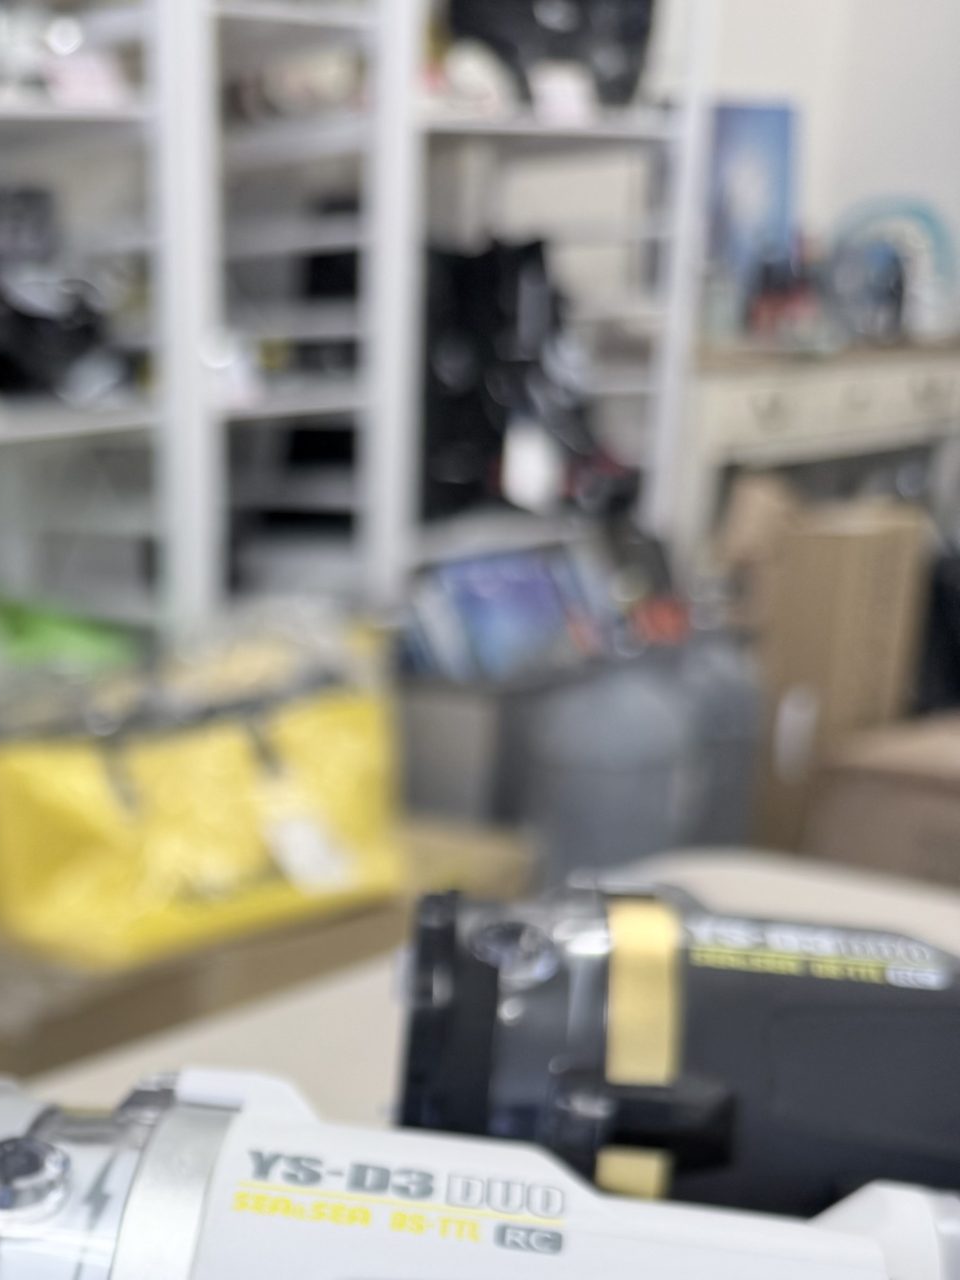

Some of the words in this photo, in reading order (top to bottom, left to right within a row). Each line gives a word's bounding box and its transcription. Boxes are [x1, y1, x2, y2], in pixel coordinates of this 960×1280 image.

[248, 1150, 434, 1201] YS-D3
[445, 1174, 566, 1219] DUO
[232, 1191, 373, 1227] SEA&SEA
[502, 1227, 554, 1252] RC
